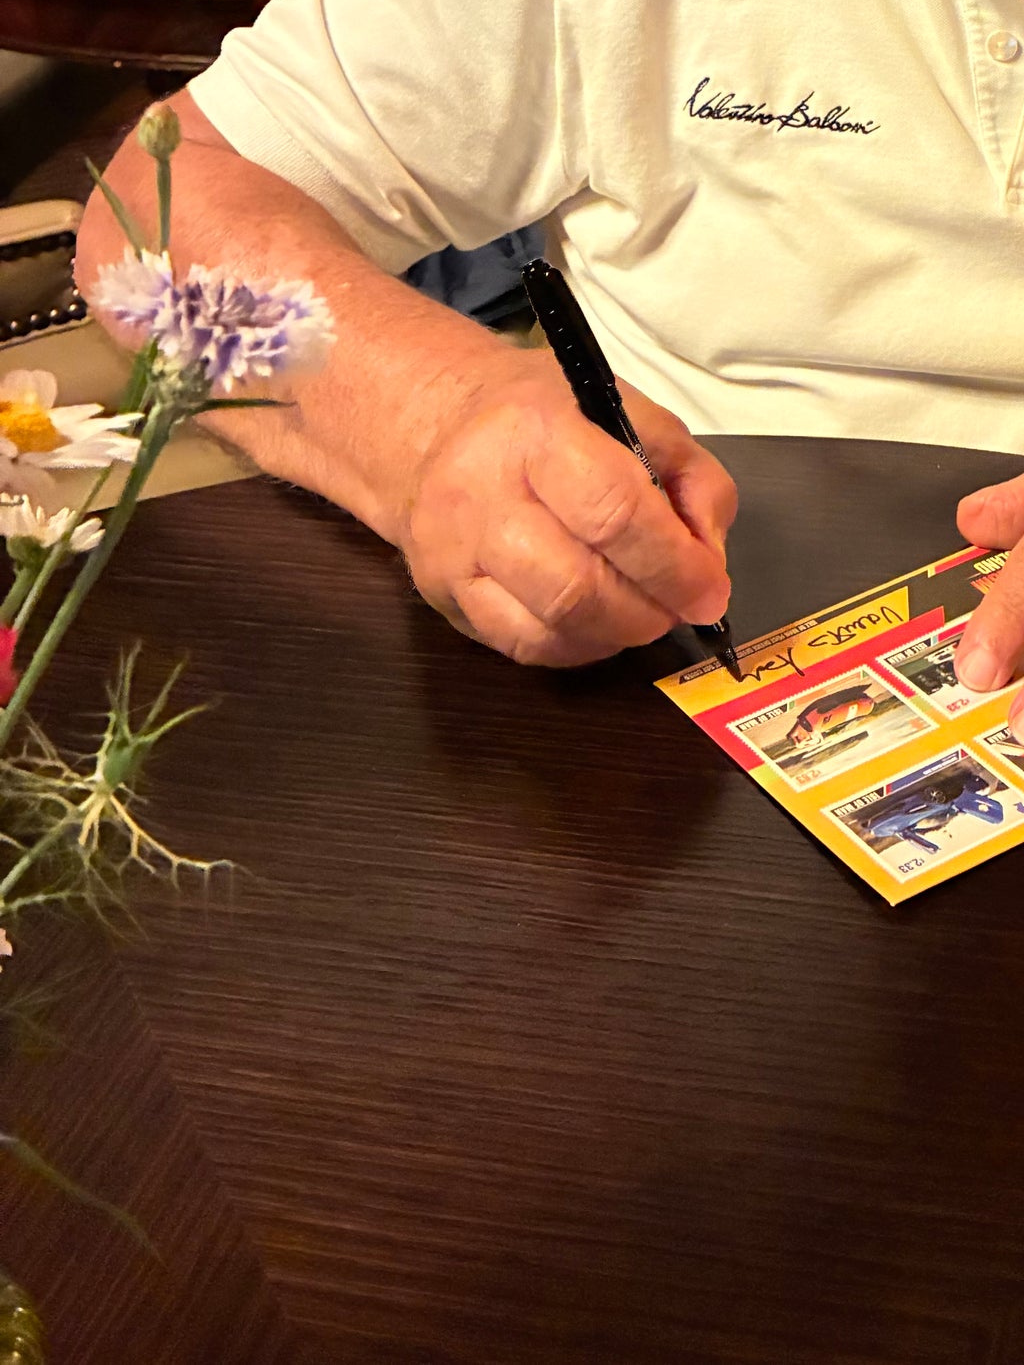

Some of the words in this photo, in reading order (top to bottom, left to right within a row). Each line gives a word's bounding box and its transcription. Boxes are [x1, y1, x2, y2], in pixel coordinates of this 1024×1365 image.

[757, 715, 769, 724] OF
[766, 708, 783, 720] ISLE
[739, 719, 759, 732] MAN
[862, 790, 879, 804] ISLE
[834, 803, 854, 817] MAN
[853, 799, 866, 809] OF
[898, 857, 925, 874] £2.33
